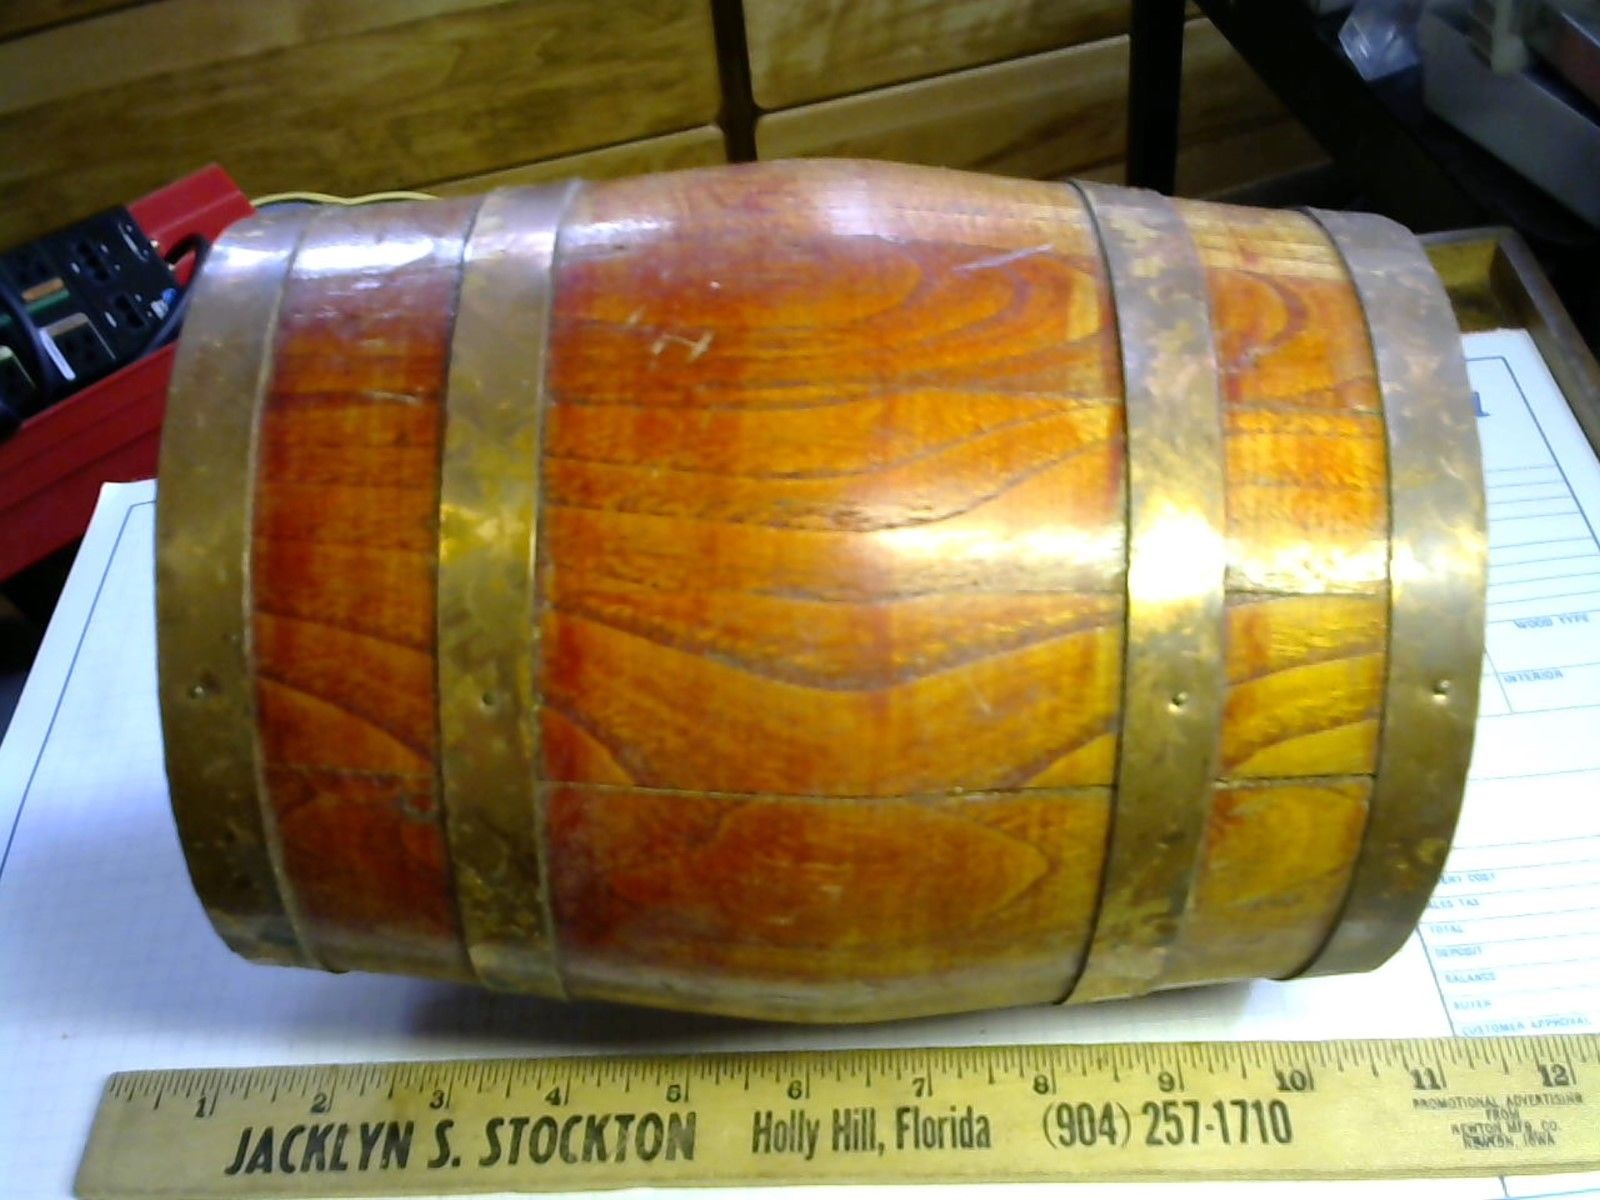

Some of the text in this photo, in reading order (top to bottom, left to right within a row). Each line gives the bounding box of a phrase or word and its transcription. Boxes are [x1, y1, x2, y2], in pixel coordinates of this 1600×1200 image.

[310, 1092, 328, 1113] 2
[429, 1089, 445, 1110] 3
[544, 1085, 562, 1106] 4
[665, 1084, 682, 1103] 5
[786, 1080, 803, 1100] 6
[912, 1077, 926, 1098] 7
[1033, 1075, 1049, 1095] 8
[1157, 1071, 1175, 1092] 9
[1275, 1069, 1308, 1091] 10
[1410, 1067, 1442, 1090] 11
[1539, 1063, 1569, 1087] 12
[1412, 1091, 1584, 1110] PROMOTIONAL ADVERTISING
[223, 1111, 697, 1176] JACKLYN S. STOCKTON
[751, 1099, 1293, 1161] Holly Hill, Florida (904) 257-1710
